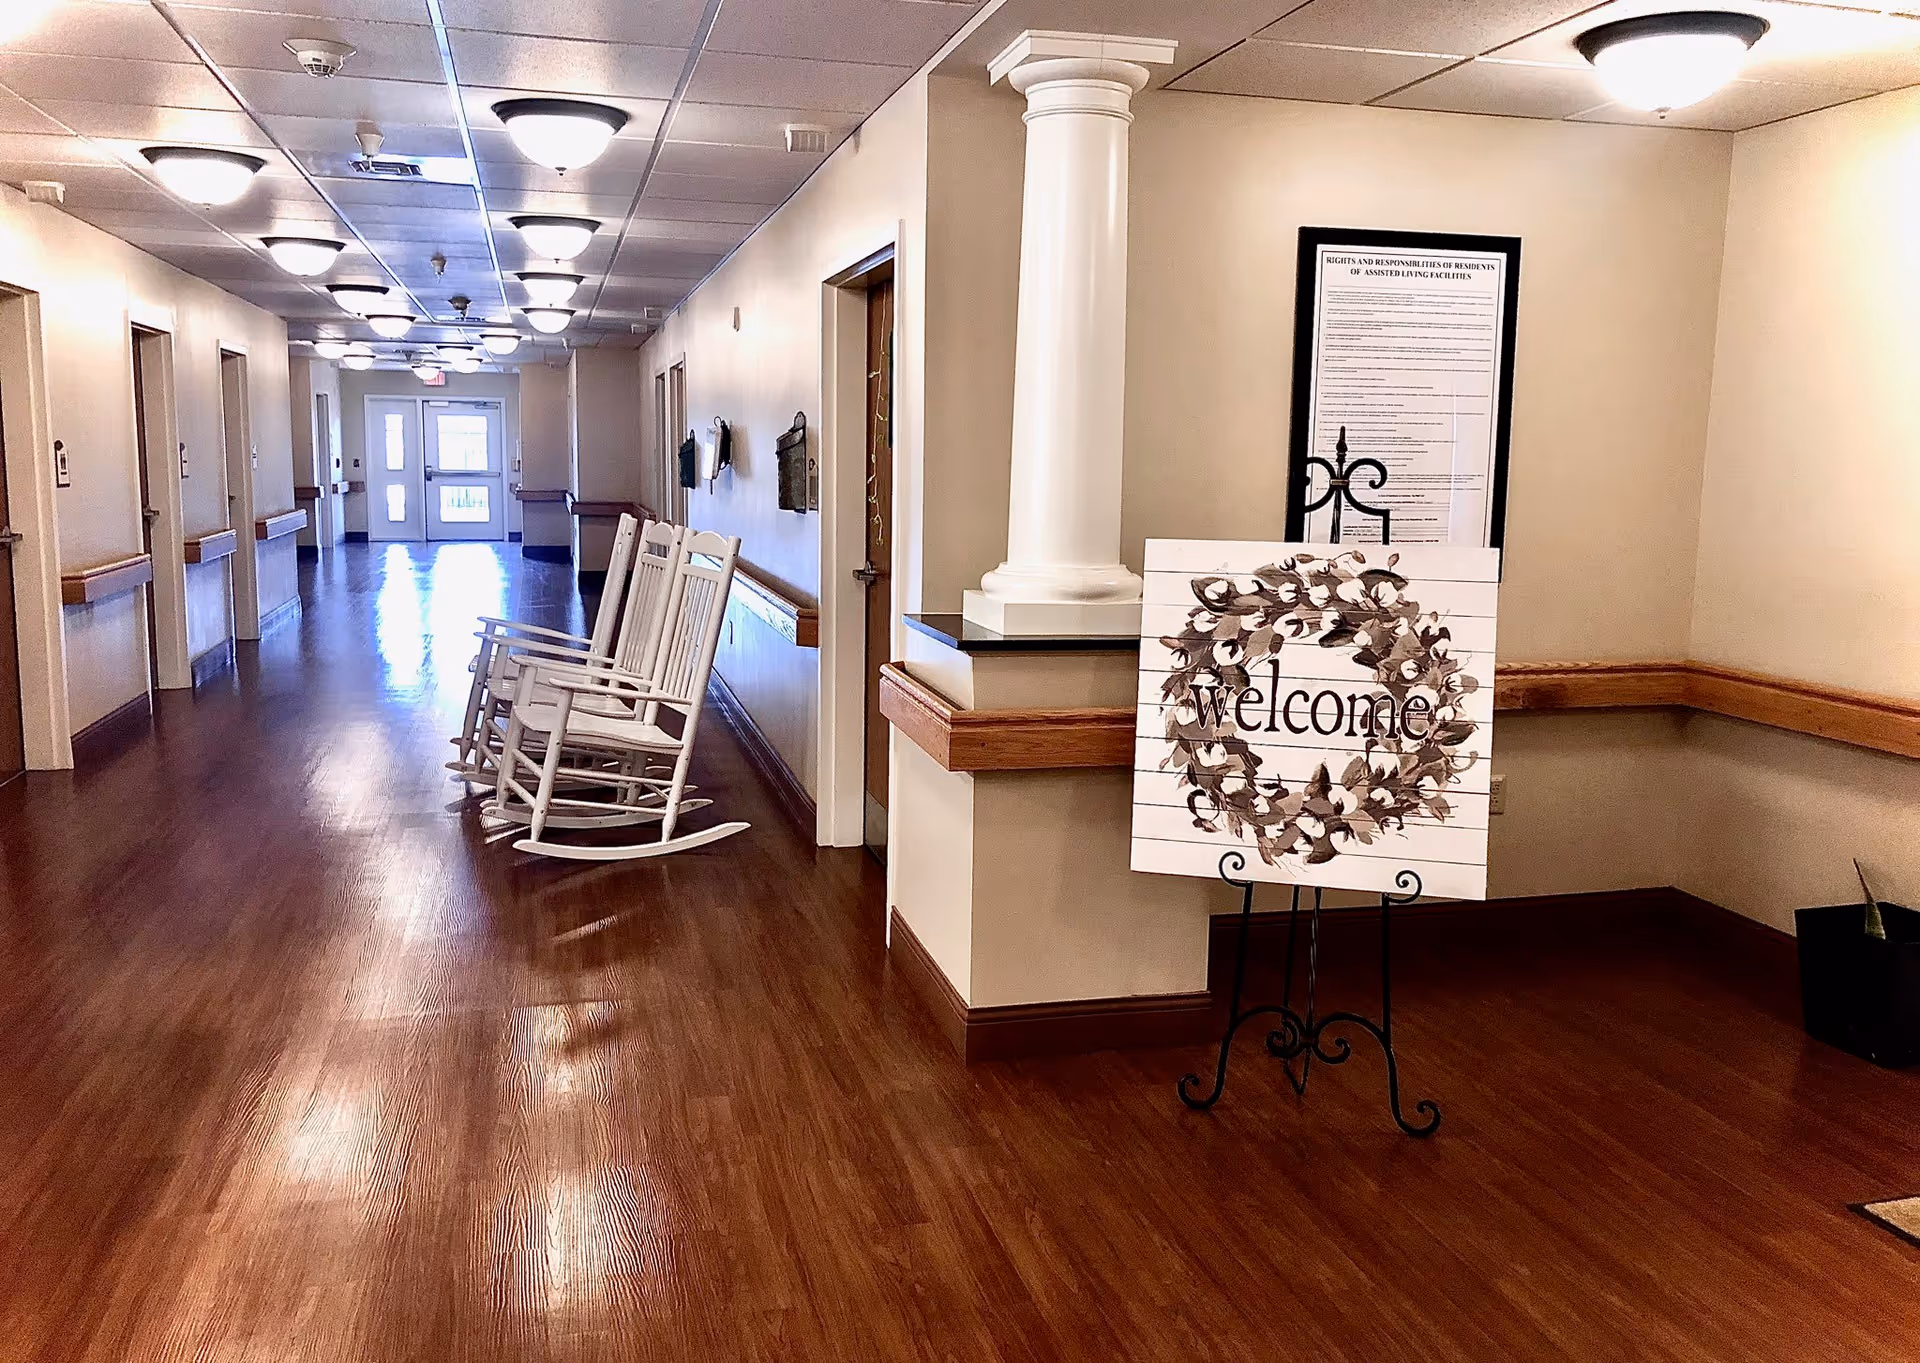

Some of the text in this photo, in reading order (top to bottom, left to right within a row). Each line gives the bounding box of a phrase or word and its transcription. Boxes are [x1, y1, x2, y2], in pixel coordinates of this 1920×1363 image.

[1326, 256, 1356, 265] RIGHTS
[1443, 261, 1453, 269] OF
[1454, 263, 1495, 271] RESIDENTS
[1350, 268, 1472, 280] OF ASSISTED LIVING FACILITIES
[1189, 659, 1430, 740] welcome
